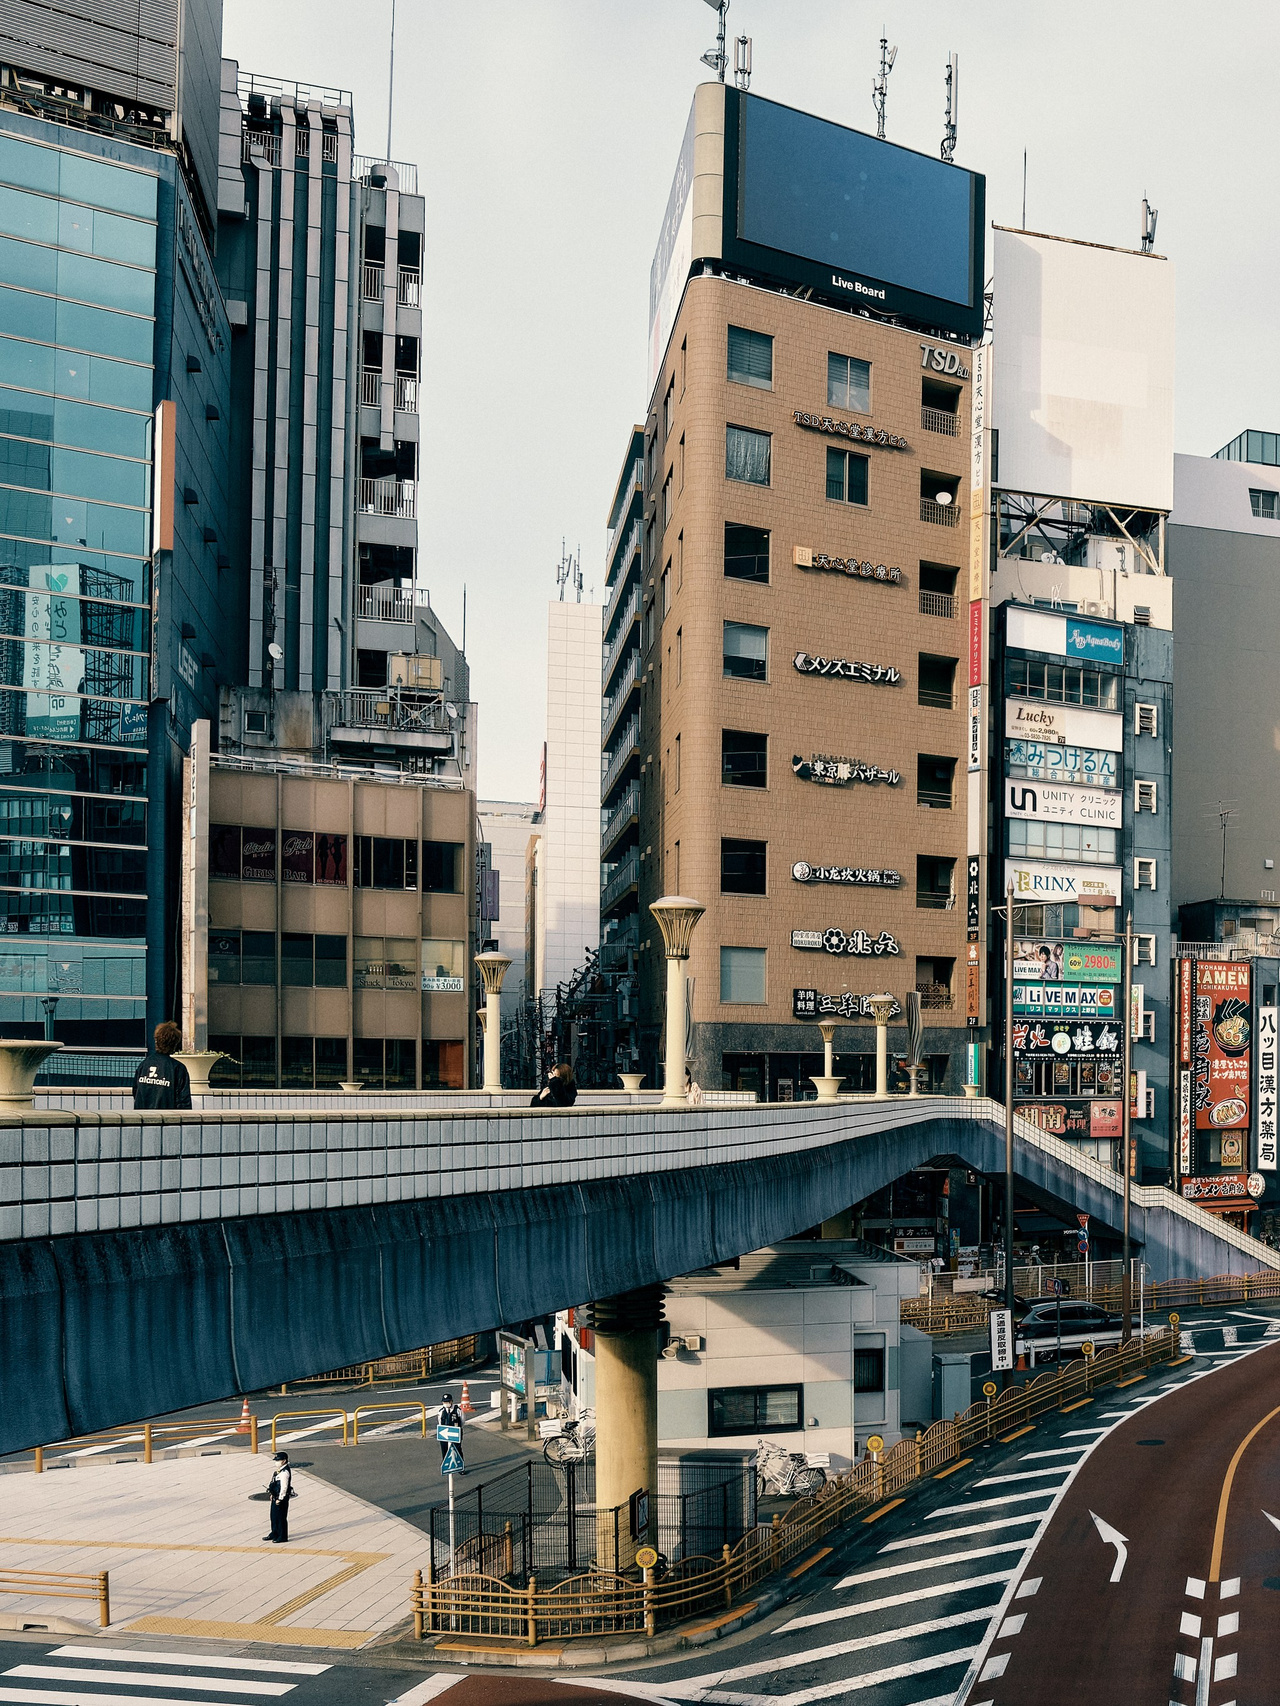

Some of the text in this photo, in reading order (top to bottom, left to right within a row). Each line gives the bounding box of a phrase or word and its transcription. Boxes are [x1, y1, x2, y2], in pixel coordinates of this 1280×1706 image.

[832, 275, 885, 300] Live Board
[920, 343, 959, 374] TSD
[818, 554, 902, 583] 天心堂診療所
[808, 656, 900, 682] メンズエミナル
[1016, 707, 1055, 726] Lucky
[1028, 744, 1116, 775] みつけるん
[1031, 767, 1110, 786] 総合不動産
[1042, 790, 1116, 806] UNITY クリニック
[1043, 805, 1116, 820] ユニティ CLINIC
[284, 869, 307, 881] BAR
[1033, 875, 1076, 893] RINX
[1029, 990, 1060, 1003] LiVE
